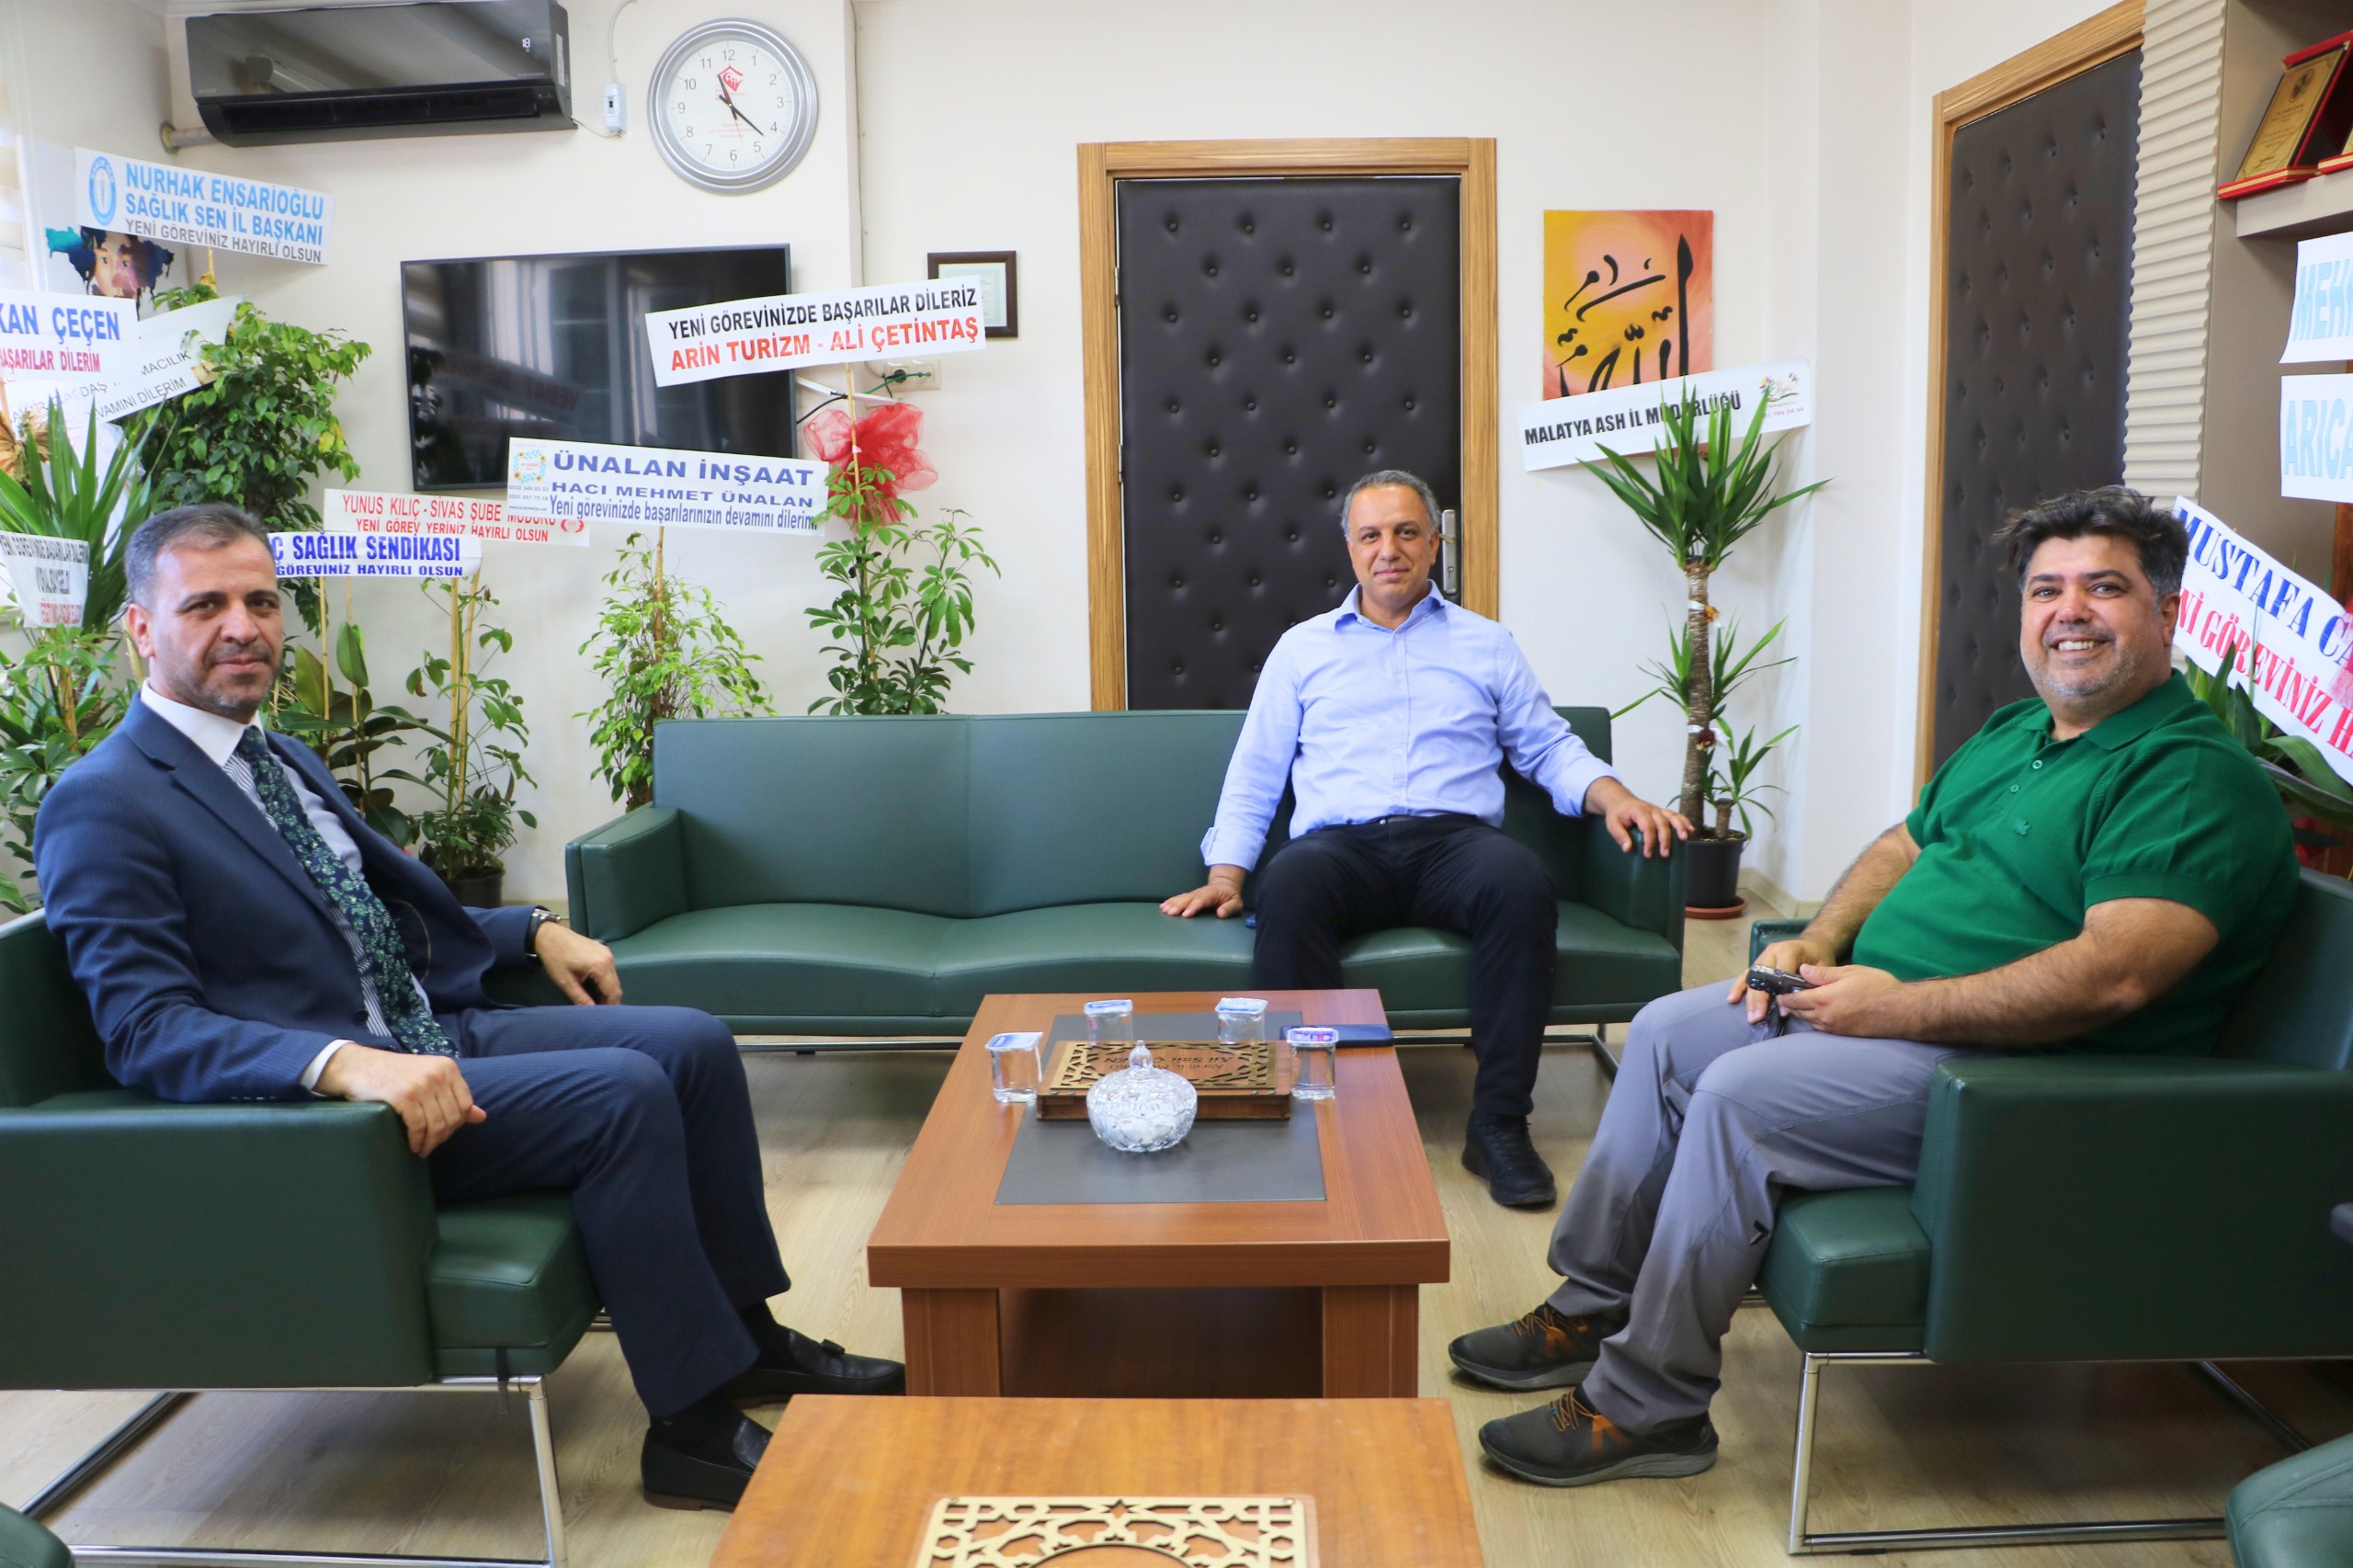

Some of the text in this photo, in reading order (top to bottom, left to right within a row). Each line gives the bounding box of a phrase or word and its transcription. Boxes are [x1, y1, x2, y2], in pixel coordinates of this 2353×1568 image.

[700, 58, 711, 70] 11
[722, 49, 735, 61] 12
[751, 55, 756, 66] 1
[684, 78, 697, 90] 10
[769, 74, 777, 85] 2
[677, 102, 686, 114] 9
[777, 97, 784, 108] 3
[686, 125, 694, 137] 8
[770, 121, 778, 132] 4
[705, 143, 713, 155] 7
[730, 149, 738, 161] 6
[754, 141, 761, 153] 5
[125, 162, 206, 200] NURHAK
[211, 179, 324, 220] ENSARİOĞLU
[125, 192, 324, 245] SAĞLIK SEN İL BAŞKANI
[125, 219, 322, 263] YENİ GÖREVİNİZ HAYIRLI OLSUN
[52, 306, 120, 347] ÇEÇEN
[669, 312, 706, 340] YENİ
[710, 303, 817, 335] GÖREVİNİZDE
[823, 294, 910, 324] BAŞARILAR
[915, 287, 978, 312] DİLERİZ
[671, 341, 721, 371] ARİN
[726, 329, 811, 361] TURİZM
[830, 324, 864, 352] ALİ
[871, 315, 979, 353] ÇETİNTAŞ
[0, 347, 101, 374] AŞARILAR DİLERİM
[136, 377, 188, 403] DİLERİM
[1525, 418, 1593, 446] MALATYA
[1596, 412, 1626, 434] ASH
[1630, 408, 1643, 428] İL
[553, 449, 814, 486] ÜNALAN İNŞAAT
[551, 482, 813, 508] HACI MEHMET ÜNALAN
[343, 494, 383, 515] YUNUS
[390, 497, 420, 518] KILIÇ
[430, 495, 464, 519] SİVAS
[471, 502, 502, 524] ŞUBE
[550, 494, 574, 516] Yeni
[577, 497, 642, 520] görevinizde
[645, 500, 722, 525] başarılarınızın
[725, 506, 774, 528] devamını
[356, 517, 549, 542] YENİ GÖREV YERİNİZ HAYIRLI OLSUN
[292, 530, 358, 560] SAĞLIK
[366, 533, 460, 562] SENDİKASI
[277, 562, 463, 576] GÖREVİNİZ HAYIRLI OLSUN
[2178, 506, 2313, 640] MUSTAFA
